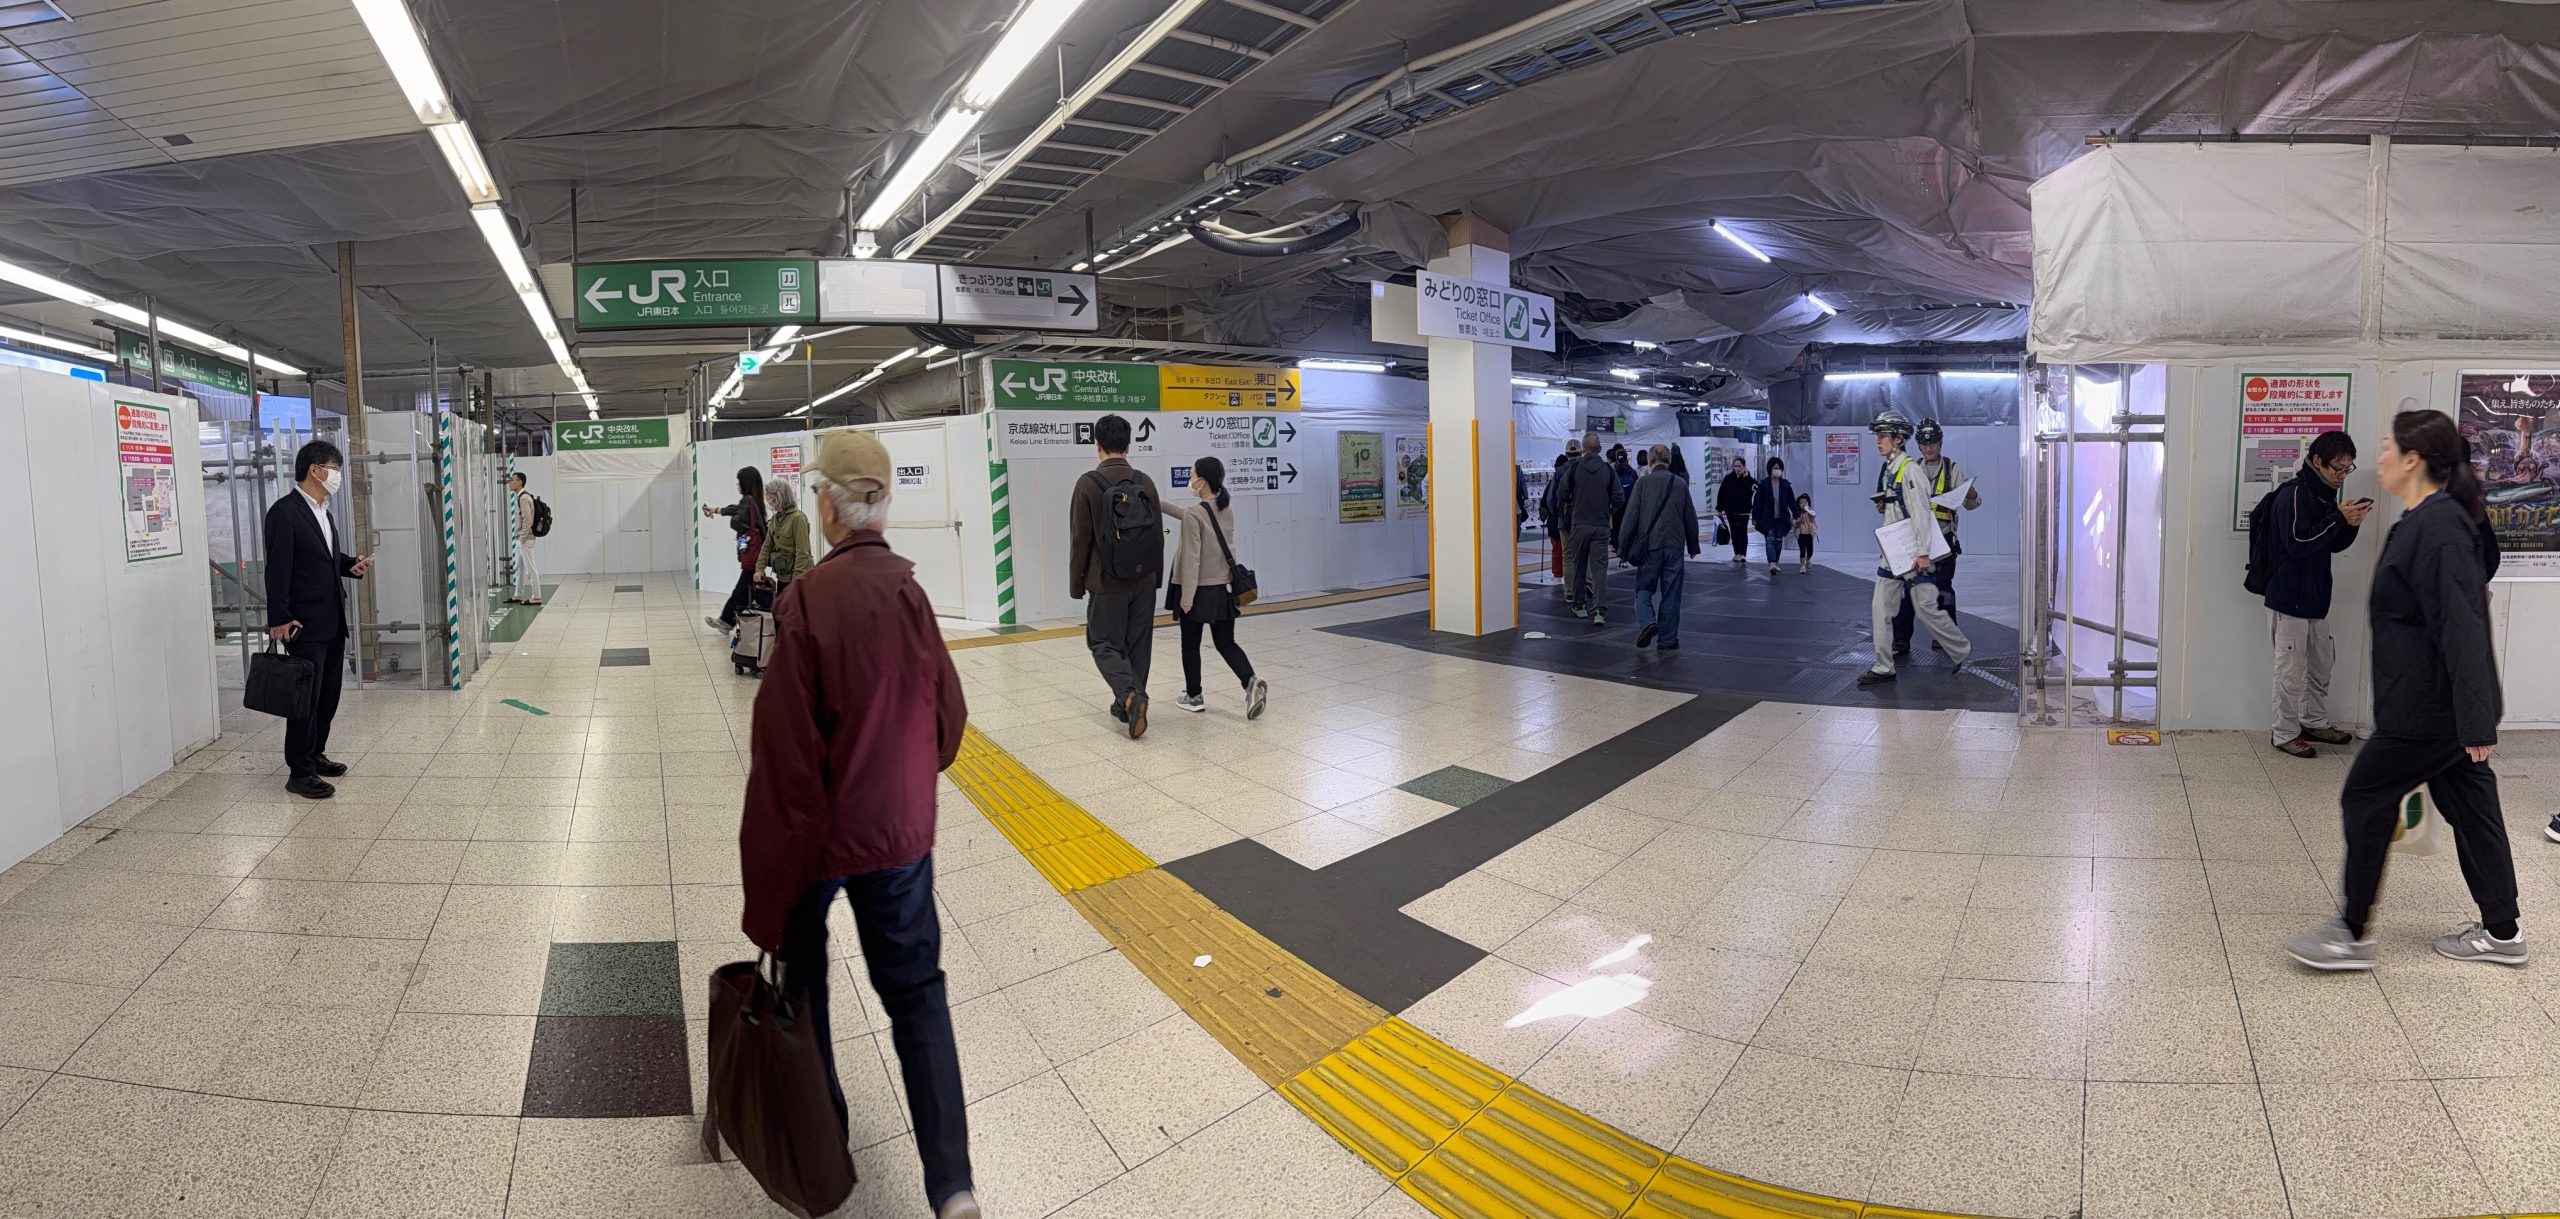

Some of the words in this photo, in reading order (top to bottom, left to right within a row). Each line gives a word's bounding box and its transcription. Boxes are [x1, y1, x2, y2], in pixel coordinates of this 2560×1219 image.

[693, 269, 729, 288] 入口
[784, 274, 794, 284] JJ
[958, 273, 1015, 287] きっぷうりば
[629, 269, 687, 304] JR
[1037, 281, 1051, 291] JR
[693, 291, 742, 302] Entrance
[994, 288, 1015, 296] Tickets
[1424, 278, 1501, 309] みどりの窓口
[637, 306, 680, 317] JR東日本
[694, 305, 712, 315] 入口
[720, 305, 759, 315] 들어가는
[1454, 307, 1478, 322] Ticket
[1479, 311, 1501, 325] Office
[133, 341, 149, 361] JR
[180, 354, 197, 371] 入口
[1029, 367, 1068, 392] JR
[1073, 369, 1120, 384] 中央改札
[1256, 373, 1276, 386] 東口
[1075, 385, 1099, 393] Central
[2270, 379, 2321, 388] 通路の形状を
[1035, 393, 1063, 401] JR東日本
[2269, 390, 2344, 400] 段階的に変更します
[1008, 422, 1071, 435] 京成線改札口
[1183, 416, 1250, 430] みどりの窓口
[579, 425, 605, 440] JR
[607, 425, 640, 434] 中央改札
[1209, 432, 1228, 440] Ticket
[1232, 432, 1250, 440] Office
[1231, 457, 1264, 466] きっぷうりば
[897, 467, 923, 476] 出入口
[1231, 476, 1265, 485] 定期券うりば
